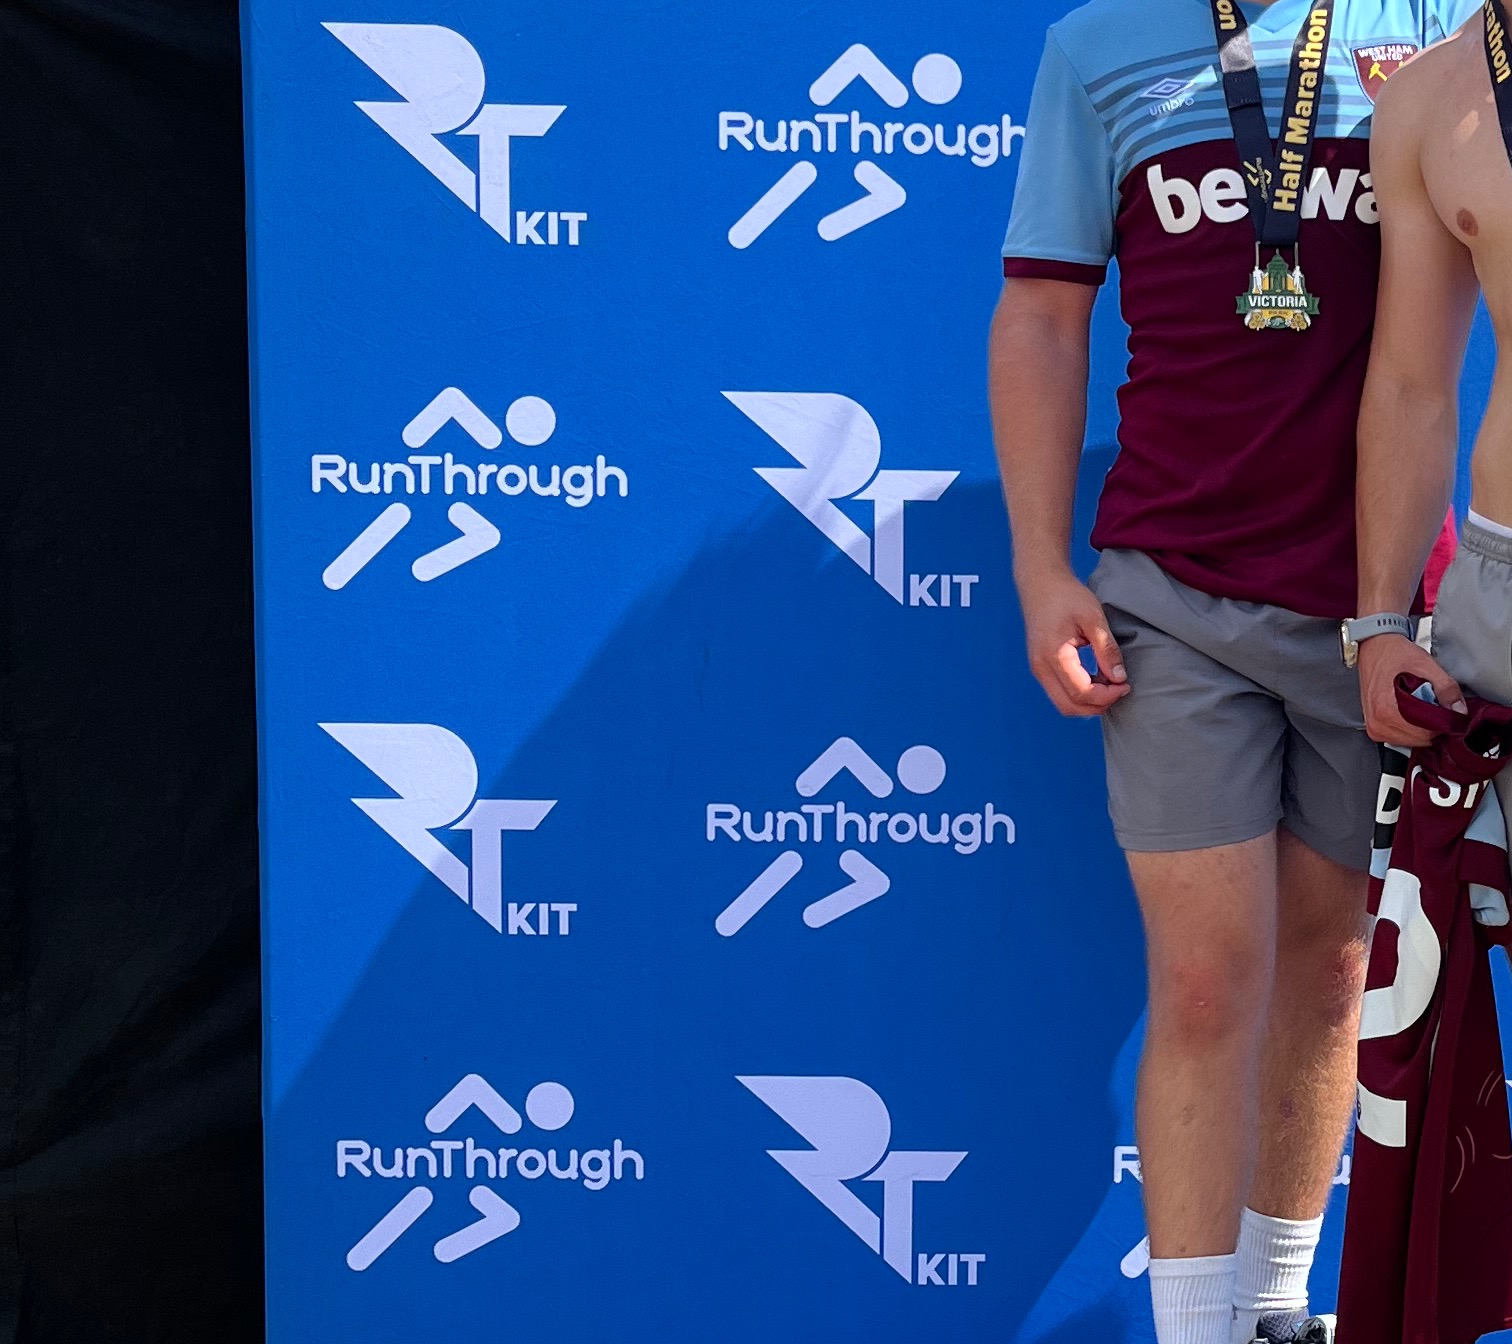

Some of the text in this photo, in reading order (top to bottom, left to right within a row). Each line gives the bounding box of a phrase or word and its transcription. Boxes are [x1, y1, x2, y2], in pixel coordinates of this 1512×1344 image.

[1358, 45, 1414, 58] WEST HAM
[1149, 97, 1195, 116] umbro
[1273, 9, 1328, 212] Half Marathon
[1146, 164, 1380, 234] bewa
[516, 211, 587, 245] KIT
[1248, 295, 1308, 308] VICTORIA
[312, 453, 628, 507] RunThrough
[910, 574, 979, 607] KIT
[707, 801, 1015, 854] RunThrough
[508, 903, 577, 935] KIT
[337, 1138, 644, 1190] RunThrough
[918, 1254, 985, 1285] KIT
